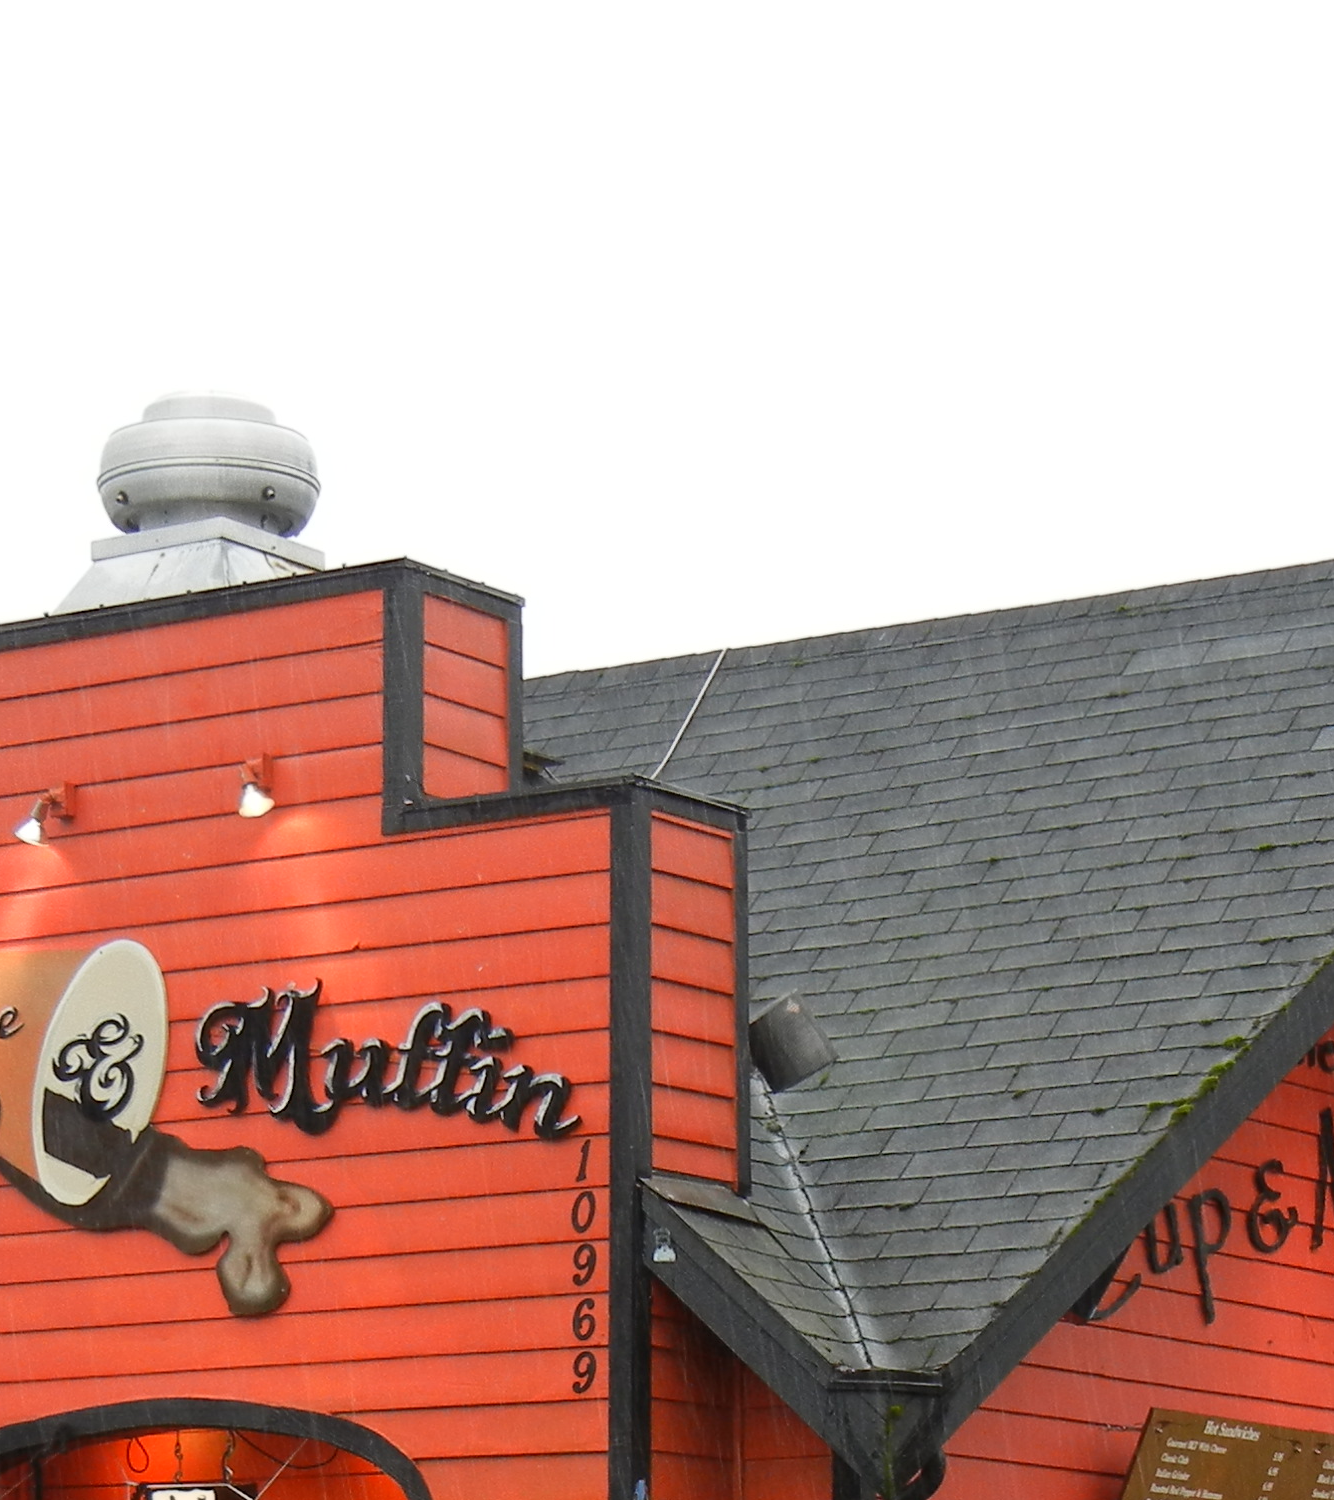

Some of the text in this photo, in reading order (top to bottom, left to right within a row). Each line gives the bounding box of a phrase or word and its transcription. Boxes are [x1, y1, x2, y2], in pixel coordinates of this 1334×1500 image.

[52, 1011, 145, 1122] &
[195, 977, 584, 1140] Muffin
[570, 1138, 598, 1397] 10969
[1247, 1158, 1297, 1253] &
[1203, 1420, 1262, 1441] Hot Sandwiches
